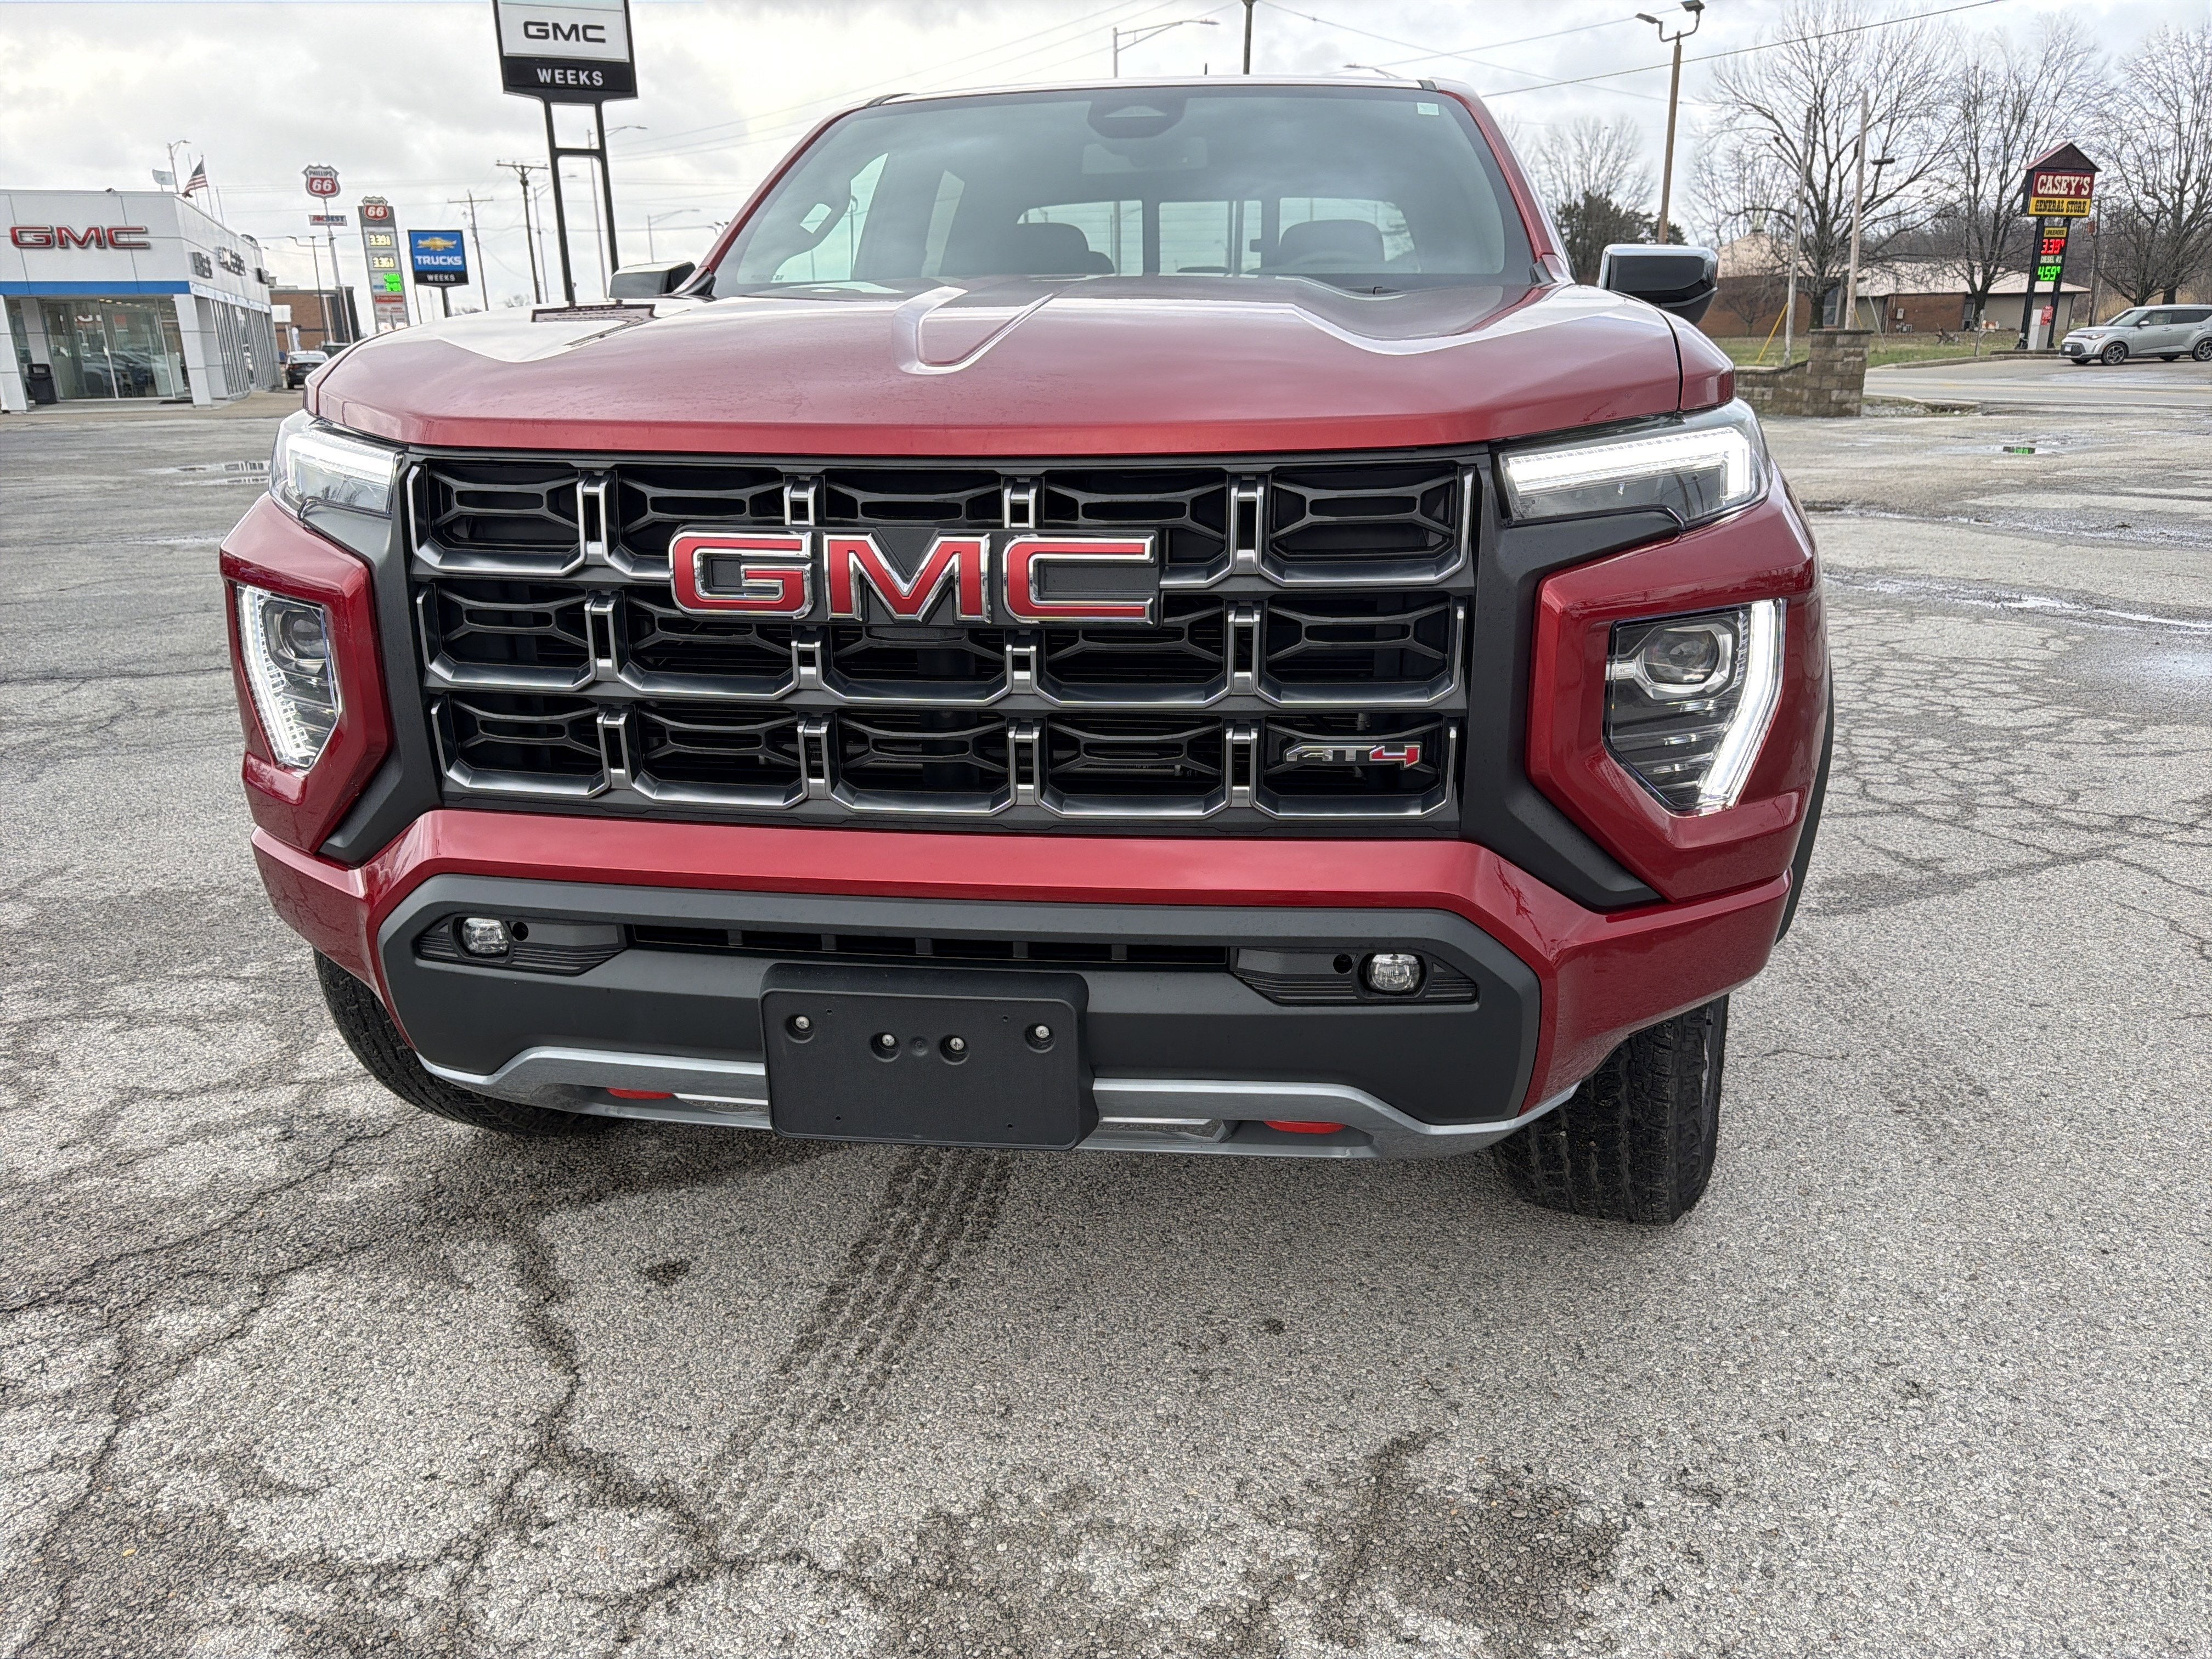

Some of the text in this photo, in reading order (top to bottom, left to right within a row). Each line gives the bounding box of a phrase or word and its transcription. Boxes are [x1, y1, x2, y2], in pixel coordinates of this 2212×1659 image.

[523, 21, 606, 43] GMC
[537, 68, 603, 86] WEEKS
[312, 179, 332, 191] 66
[2037, 175, 2091, 196] CASEY'S
[368, 206, 385, 217] 66
[2035, 199, 2087, 213] GENERAL STORE
[10, 225, 150, 249] GMC
[415, 255, 462, 266] TRUCKS
[669, 531, 1155, 625] GMC
[1285, 744, 1420, 769] AT4
